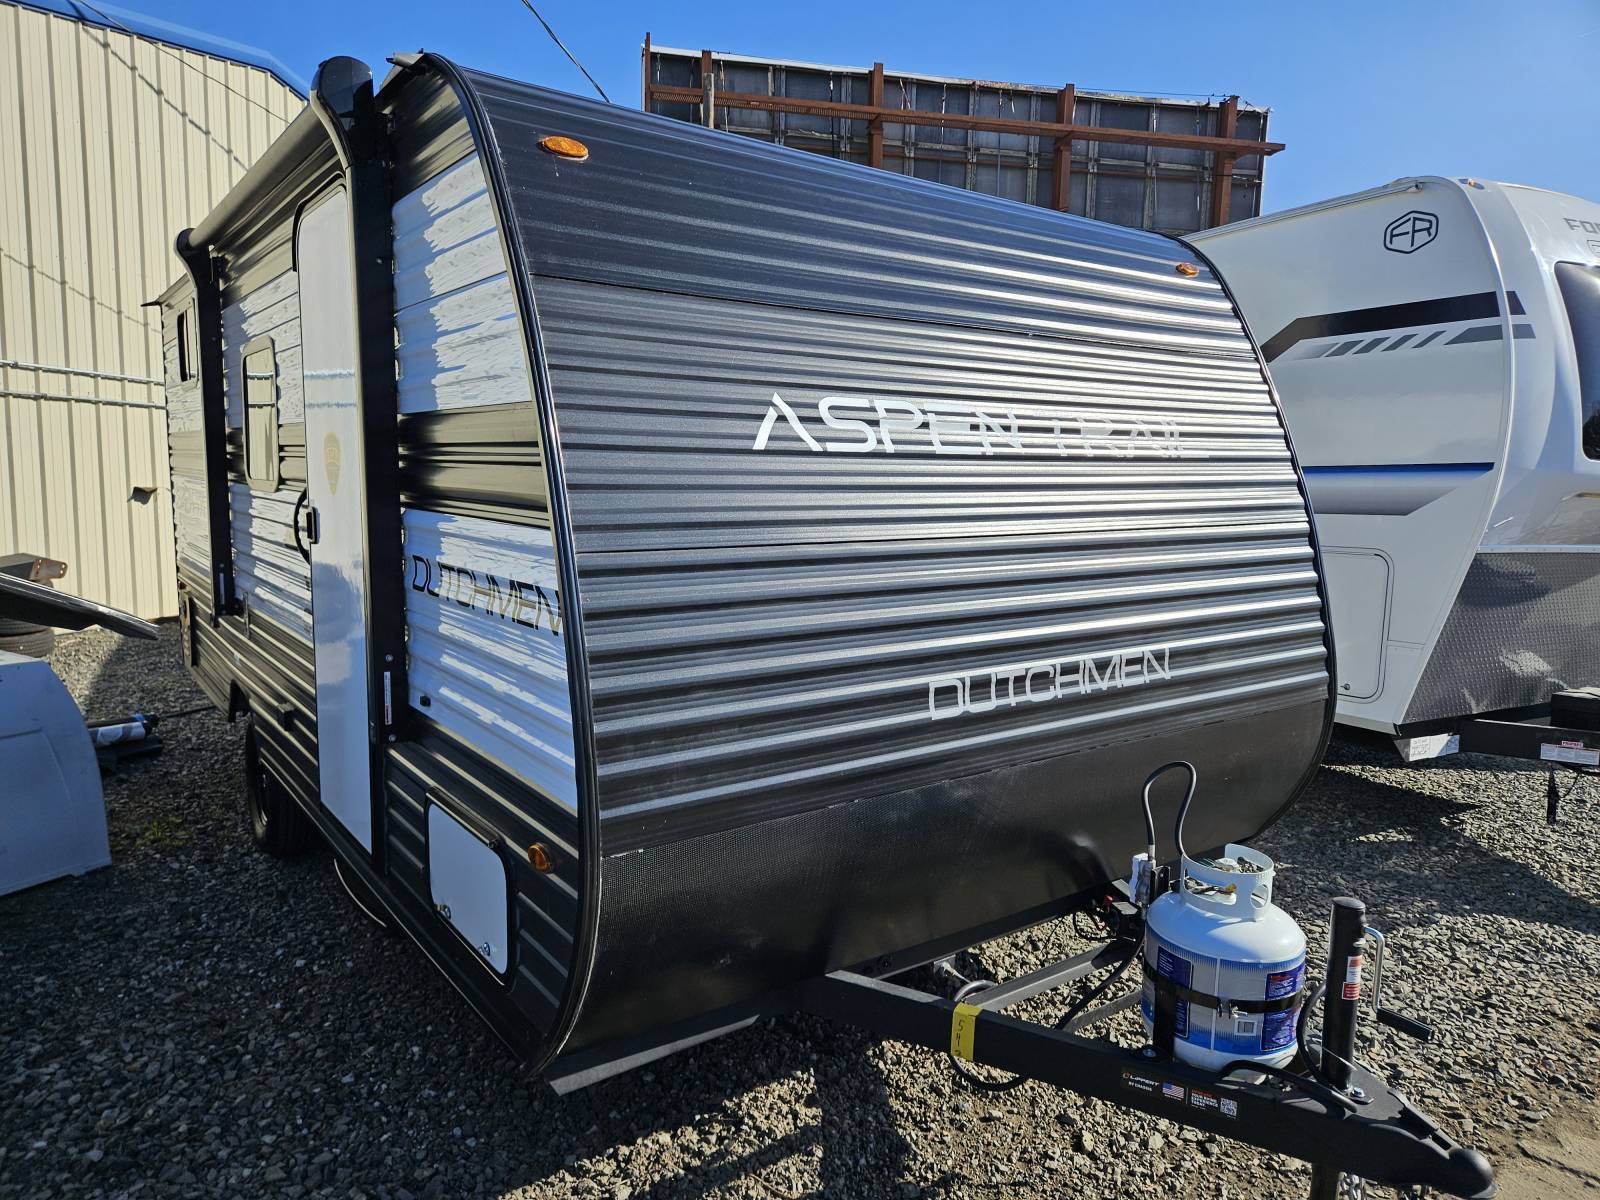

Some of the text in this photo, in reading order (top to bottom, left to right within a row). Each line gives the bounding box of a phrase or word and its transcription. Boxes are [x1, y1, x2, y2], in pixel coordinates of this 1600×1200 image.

[752, 391, 1209, 458] ASPEN TRAIL
[412, 555, 563, 636] DUTCHMEN
[928, 648, 1172, 720] DUTCHMEN
